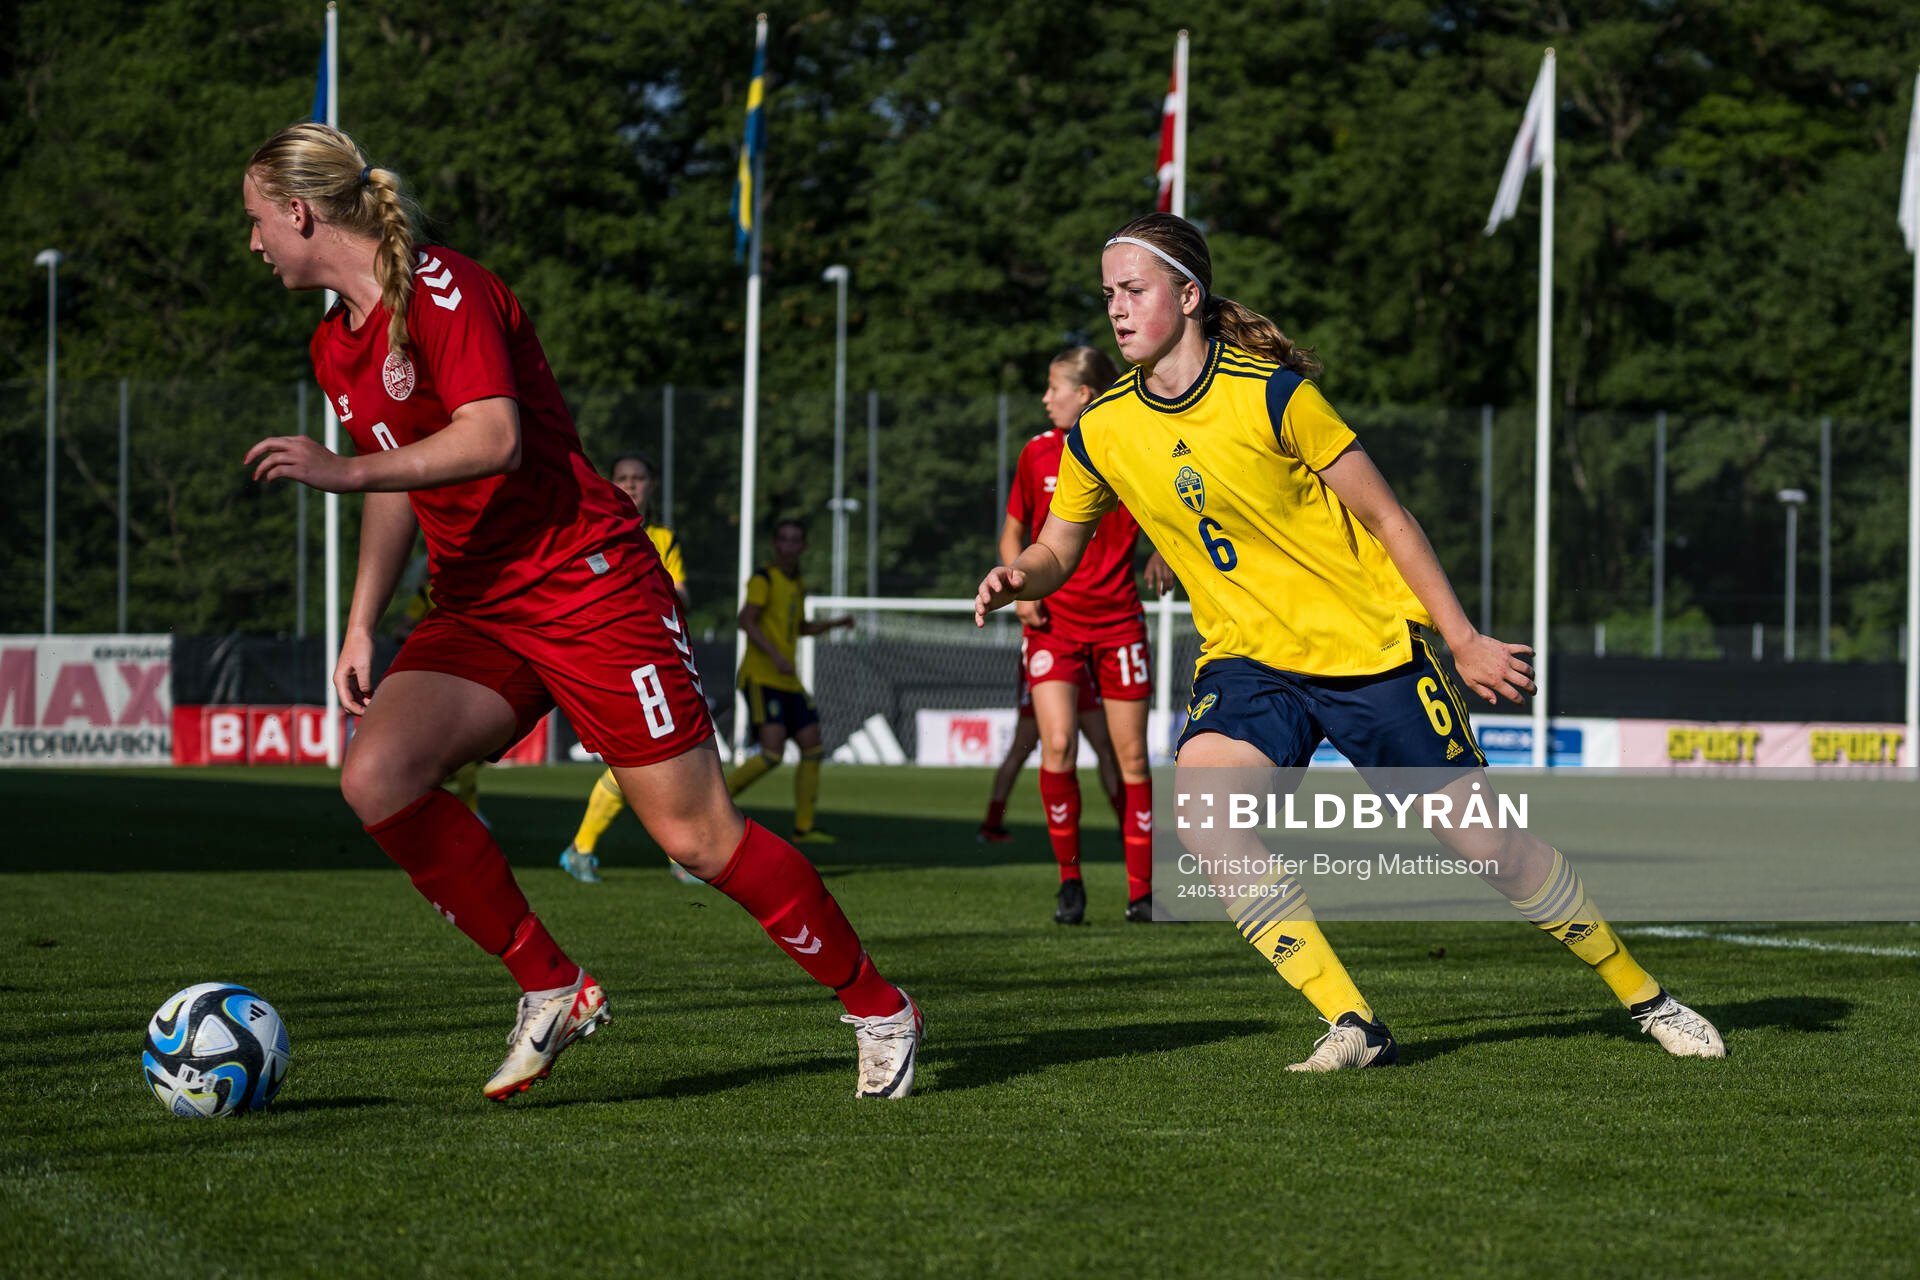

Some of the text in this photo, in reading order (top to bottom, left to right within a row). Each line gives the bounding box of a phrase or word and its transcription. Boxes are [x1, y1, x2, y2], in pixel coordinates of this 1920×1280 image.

[1172, 448, 1191, 458] adidas
[1199, 517, 1238, 572] 6
[1117, 643, 1148, 687] 15
[631, 664, 675, 738] 8
[1417, 677, 1452, 736] 6
[0, 731, 172, 758] STORMARKN
[1446, 746, 1464, 760] adidas
[1667, 726, 1761, 761] SPORT
[1810, 729, 1904, 764] SPORT
[1272, 938, 1306, 968] adidas
